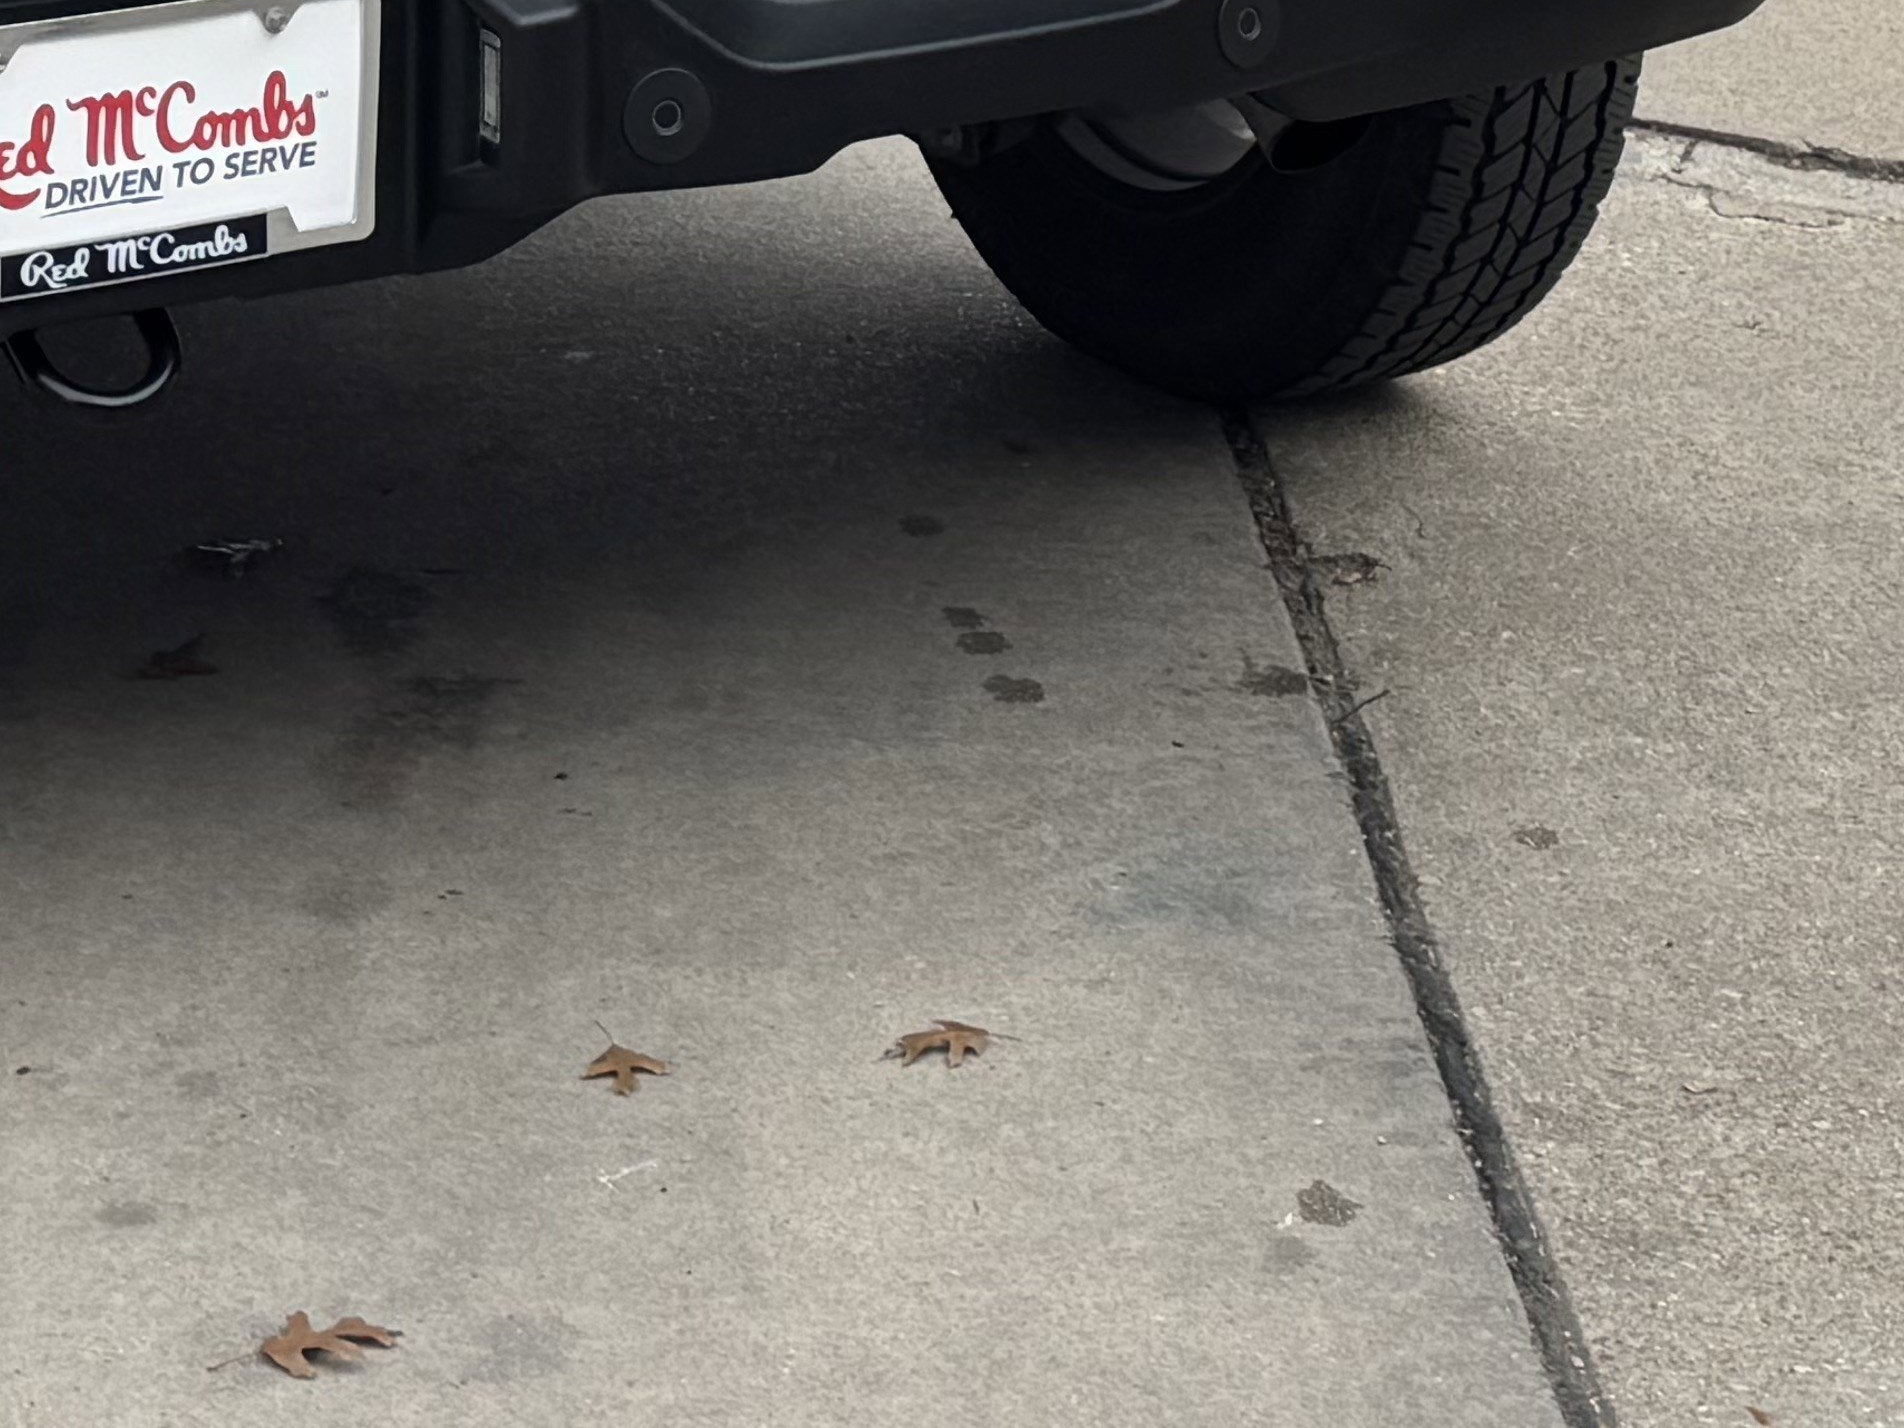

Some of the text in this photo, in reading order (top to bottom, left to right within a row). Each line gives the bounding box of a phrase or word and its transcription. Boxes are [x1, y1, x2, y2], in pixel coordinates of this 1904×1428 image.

[45, 140, 318, 210] DRIVEN TO SERVE
[19, 224, 247, 289] Red McCombs
